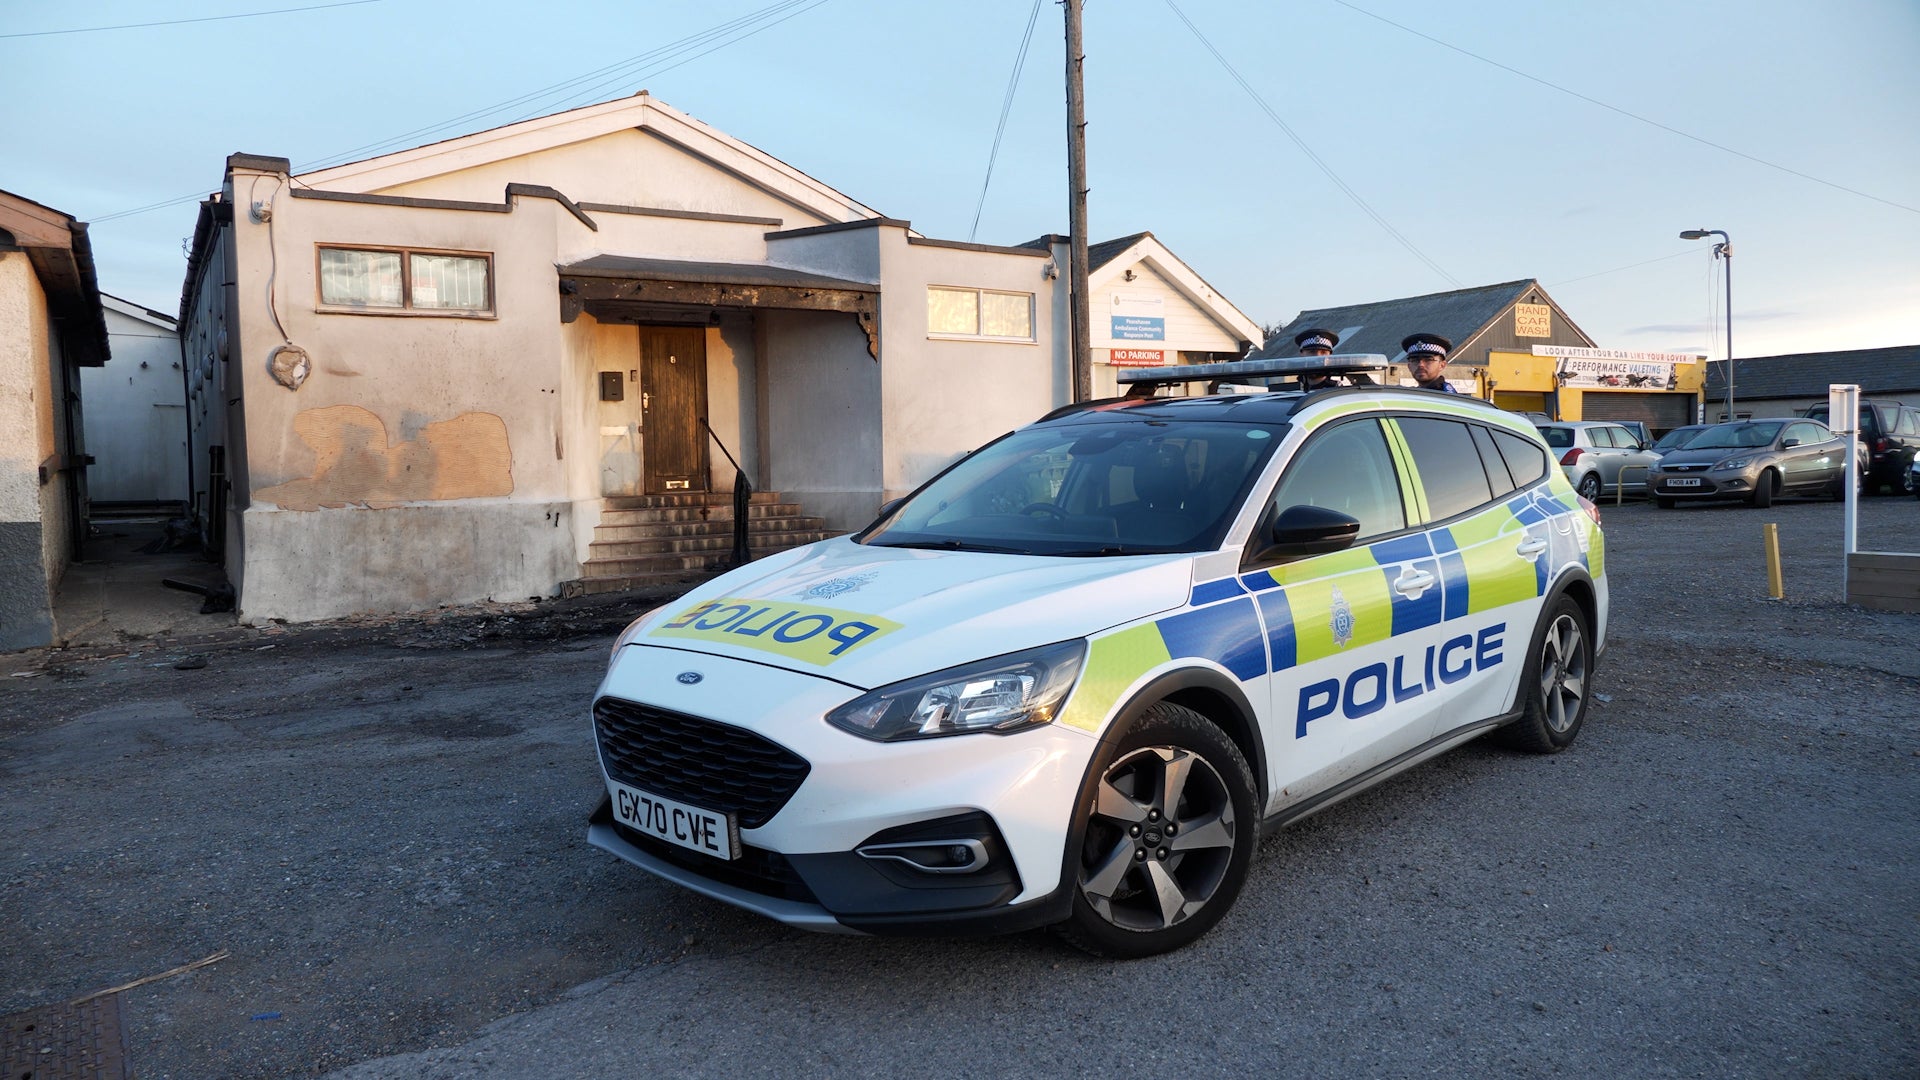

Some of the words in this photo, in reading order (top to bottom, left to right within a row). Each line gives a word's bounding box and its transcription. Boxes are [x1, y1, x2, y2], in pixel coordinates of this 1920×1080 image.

[1517, 305, 1548, 316] HAND
[1517, 316, 1548, 326] CAR
[1516, 326, 1549, 336] WASH
[1114, 350, 1127, 359] NO
[1128, 351, 1161, 360] PARKING
[1545, 347, 1565, 355] LOOK
[1568, 348, 1590, 356] AFTER
[1592, 349, 1612, 358] YOUR
[1613, 351, 1628, 359] CAR
[1647, 353, 1665, 361] YOUR
[1666, 354, 1687, 362] LOVER
[1571, 361, 1627, 373] PERFORMANCE
[1628, 363, 1661, 374] VALETING
[1295, 622, 1506, 740] POLICE
[618, 788, 668, 835] GX70
[672, 807, 719, 852] CVE
